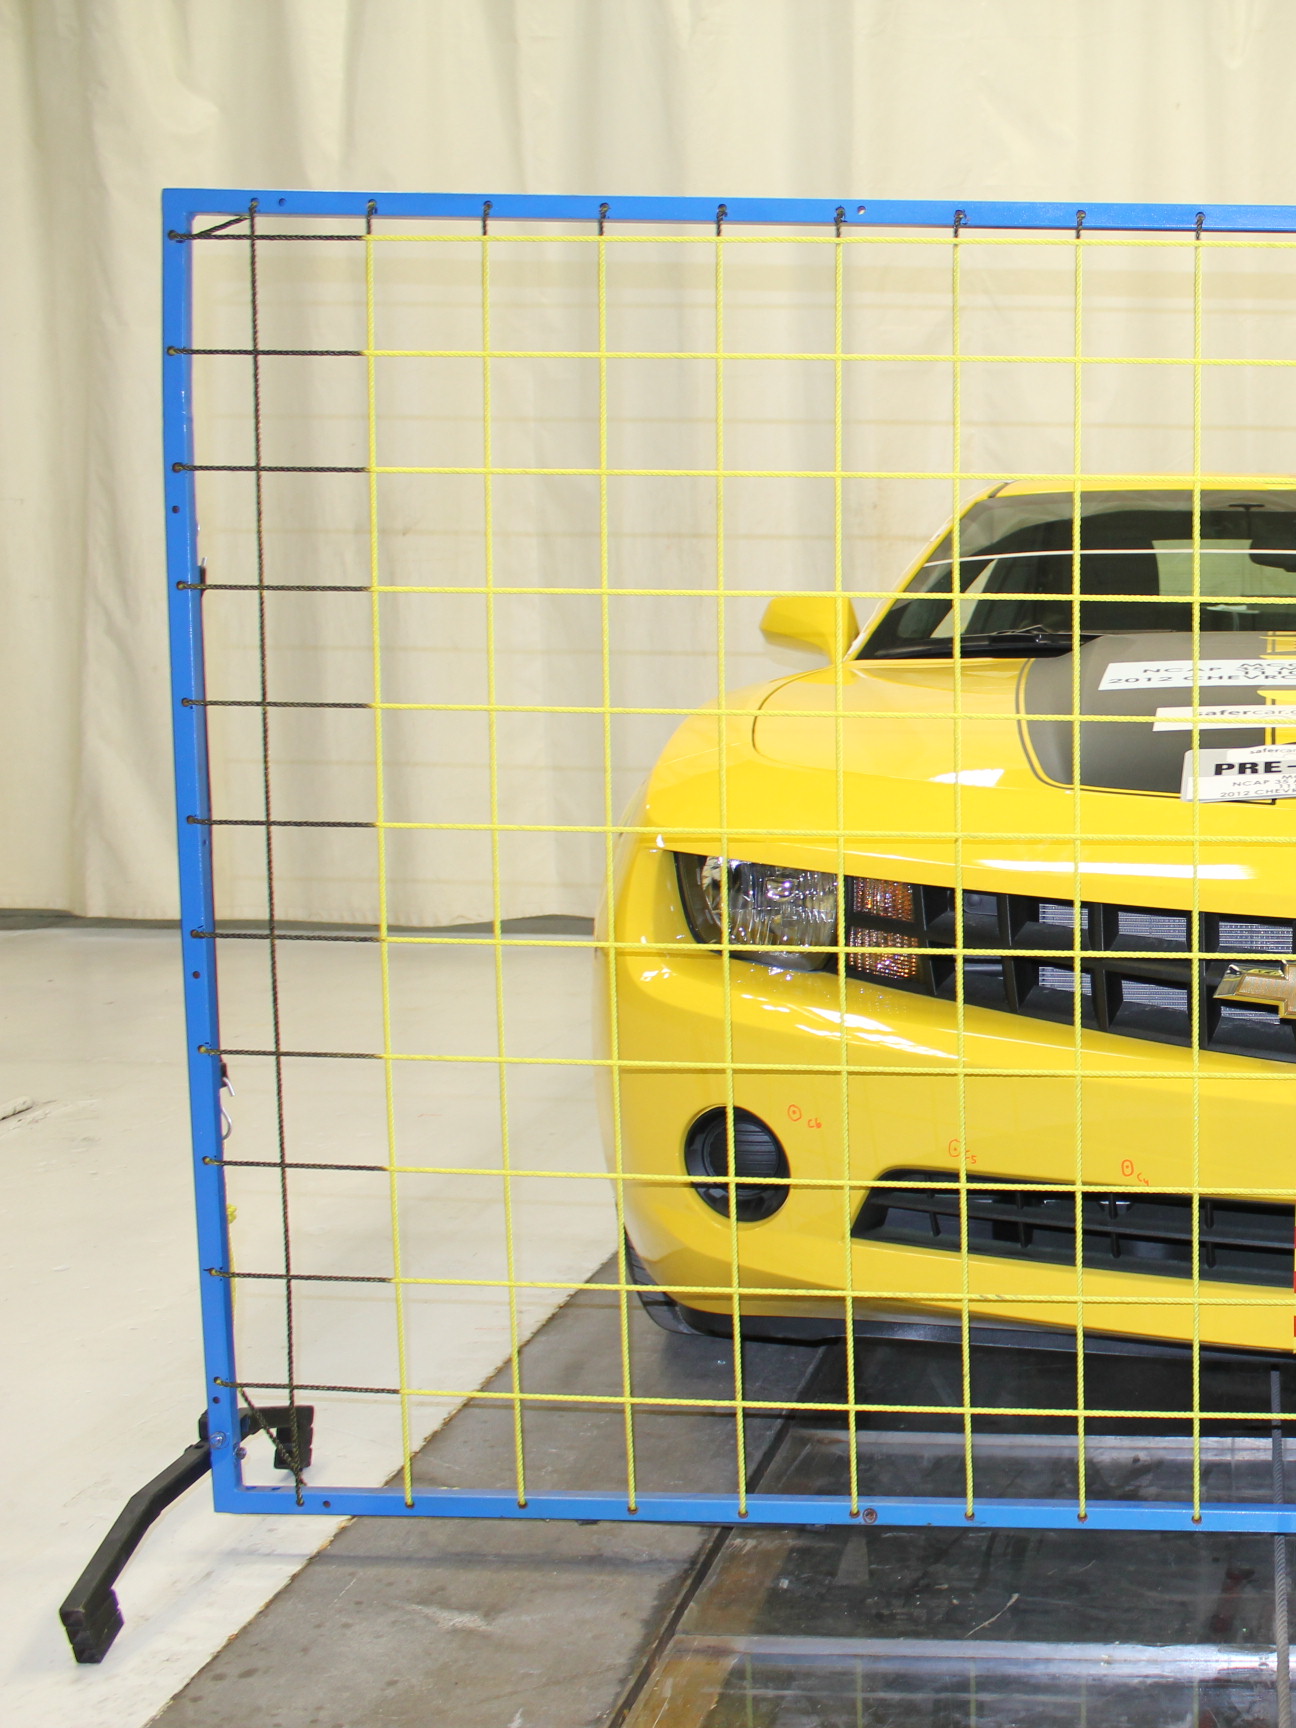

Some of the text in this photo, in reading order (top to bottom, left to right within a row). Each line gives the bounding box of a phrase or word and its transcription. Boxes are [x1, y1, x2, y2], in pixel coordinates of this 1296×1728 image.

[1107, 676, 1172, 684] 2012
[1232, 779, 1270, 787] NCAP
[1220, 790, 1250, 798] 2012
